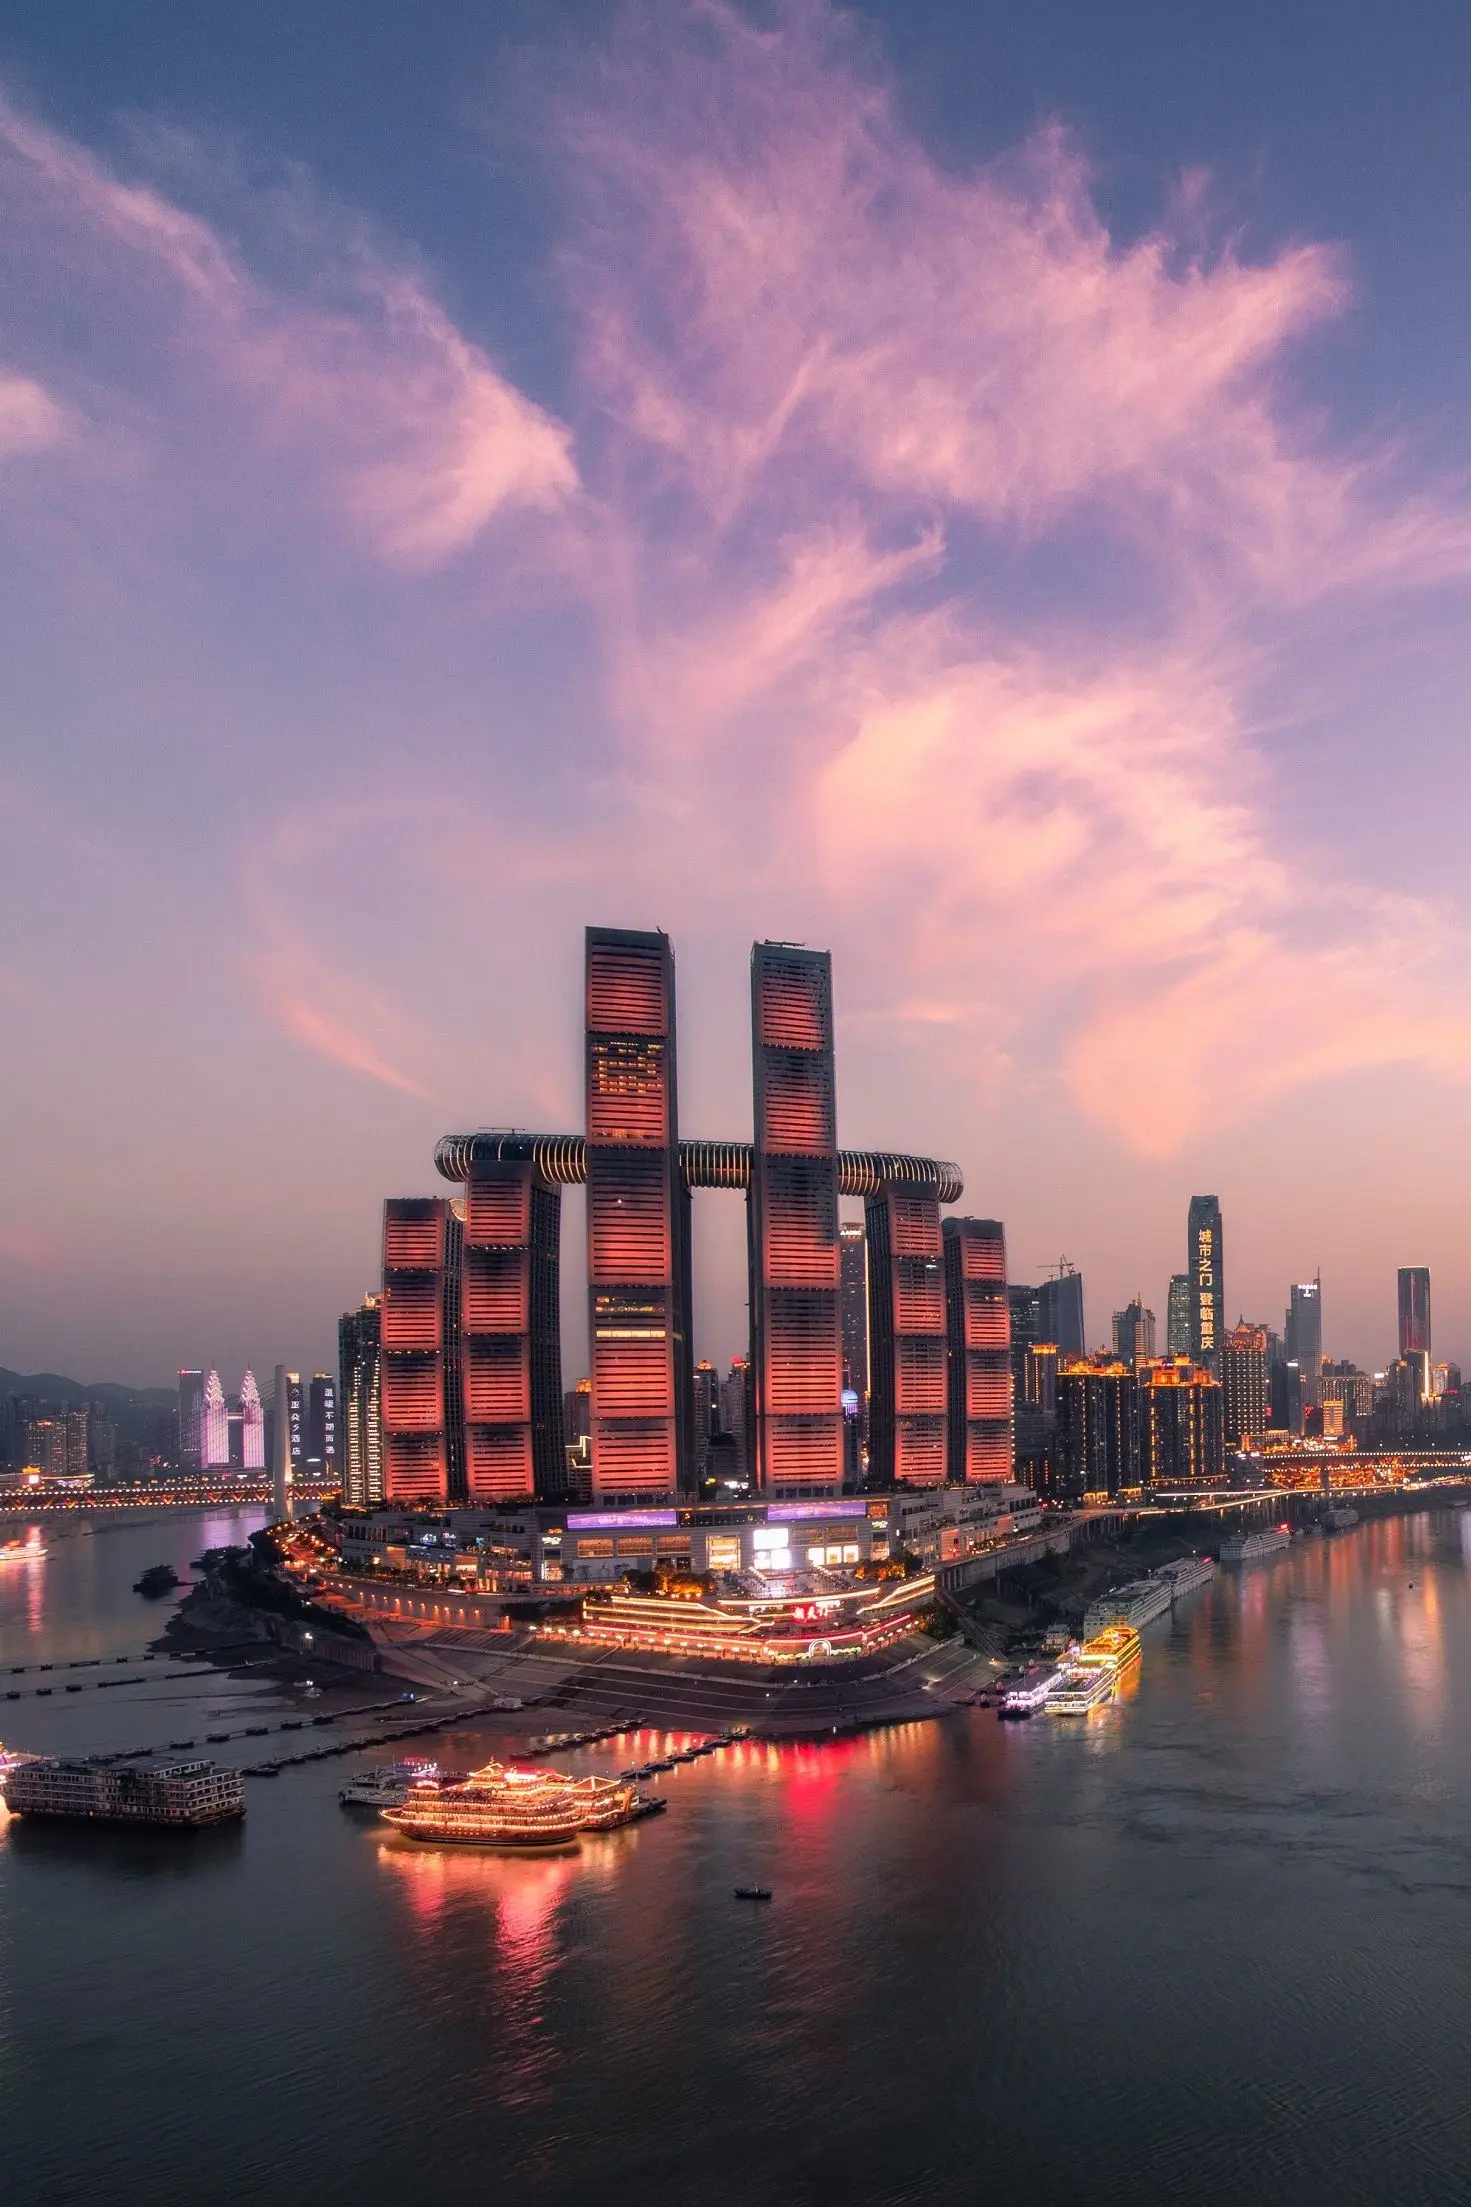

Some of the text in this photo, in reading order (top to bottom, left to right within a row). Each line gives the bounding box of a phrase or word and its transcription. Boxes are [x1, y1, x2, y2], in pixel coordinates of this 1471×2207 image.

[1199, 1229, 1214, 1349] 城市之门 登临重庆
[323, 1388, 335, 1454] 温暖不期而遇
